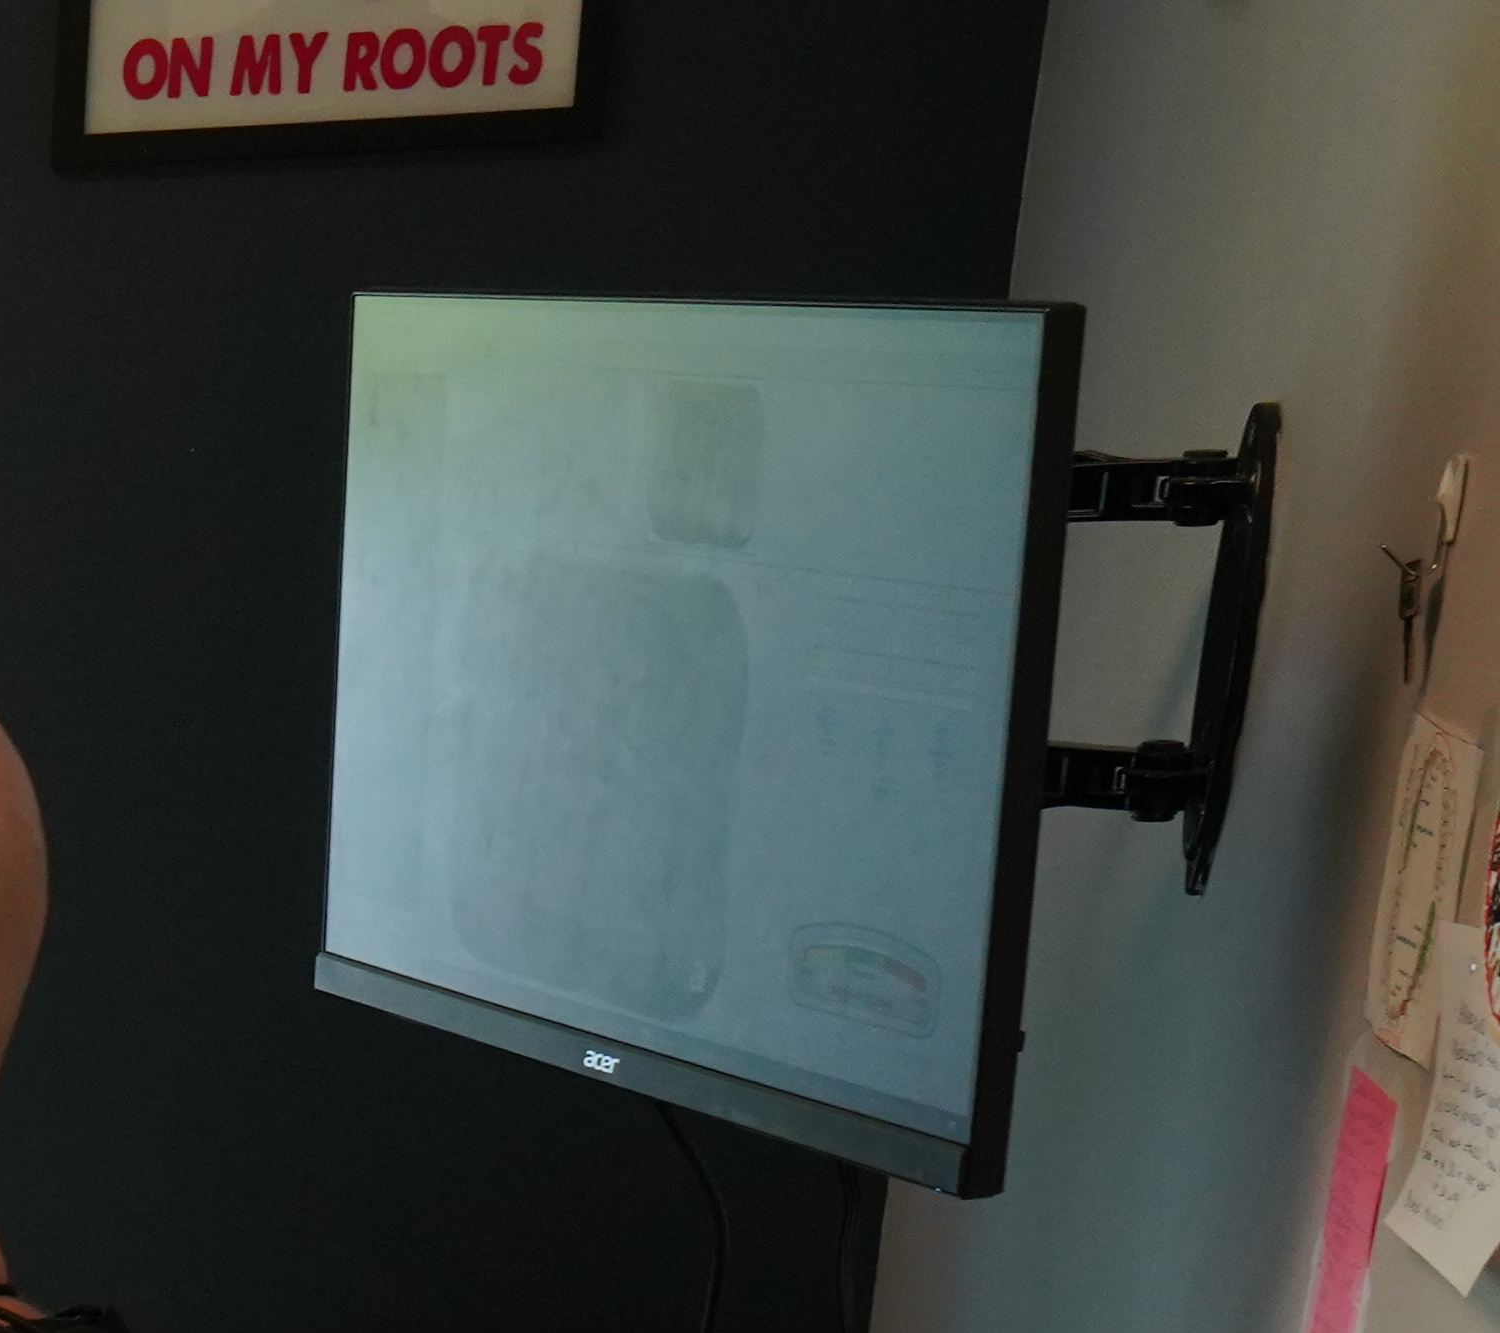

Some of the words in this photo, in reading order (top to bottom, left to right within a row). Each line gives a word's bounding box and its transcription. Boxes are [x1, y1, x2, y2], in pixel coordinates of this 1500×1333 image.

[122, 37, 214, 100] ON
[229, 31, 329, 97] MY
[342, 22, 544, 92] ROOTS
[583, 1049, 620, 1074] acer
